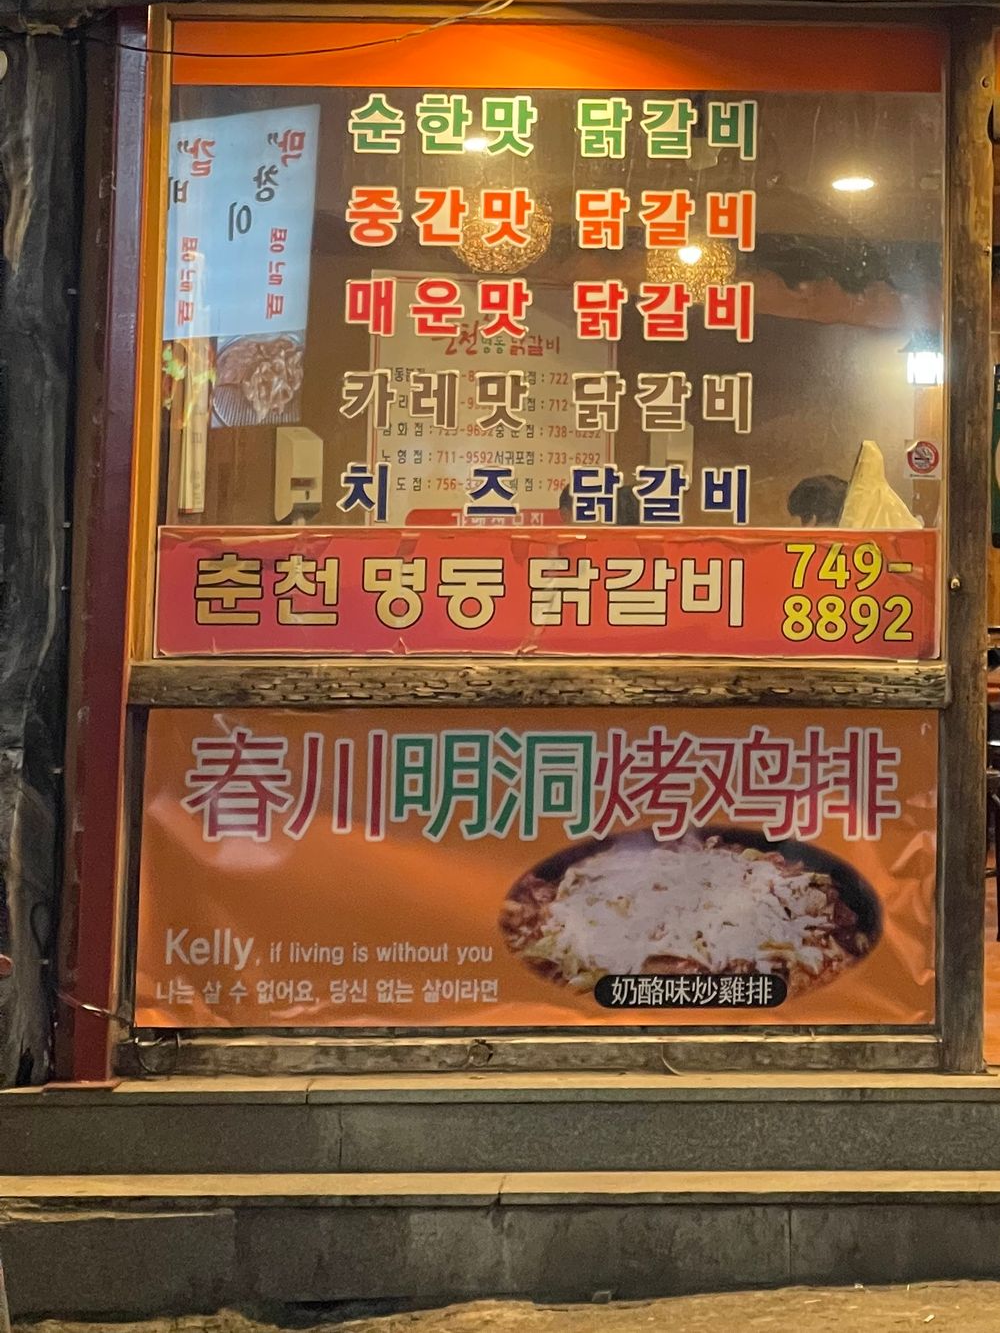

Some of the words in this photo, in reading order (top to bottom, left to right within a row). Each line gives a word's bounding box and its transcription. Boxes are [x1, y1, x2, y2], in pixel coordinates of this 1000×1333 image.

[348, 93, 539, 156] 순한맛
[577, 97, 759, 161] 닭갈비
[346, 184, 536, 250] 중간맛
[575, 187, 757, 253] 닭갈비
[344, 277, 533, 340] 매운맛
[572, 280, 755, 344] 닭갈비
[339, 369, 531, 434] 카레맛
[570, 372, 754, 436] 닭갈비
[437, 450, 494, 464] 711-9592
[548, 451, 601, 465] 733-6292
[569, 464, 752, 527] 닭갈비
[194, 554, 340, 627] 춘천
[363, 557, 507, 631] 명동
[527, 557, 744, 628] 닭갈비
[782, 595, 914, 643] 8892
[184, 724, 902, 842] 春川明洞烤鸡排
[165, 927, 261, 971] Kelly,
[289, 941, 345, 966] living
[353, 942, 369, 964] is
[376, 941, 450, 964] without
[457, 945, 494, 966] you
[155, 979, 195, 1004] 나는
[202, 979, 222, 1004] 살
[229, 980, 248, 1004] 수
[329, 979, 369, 1004] 당신
[376, 979, 414, 1004] 없는
[611, 976, 773, 1006] 奶酪味炒雞排
